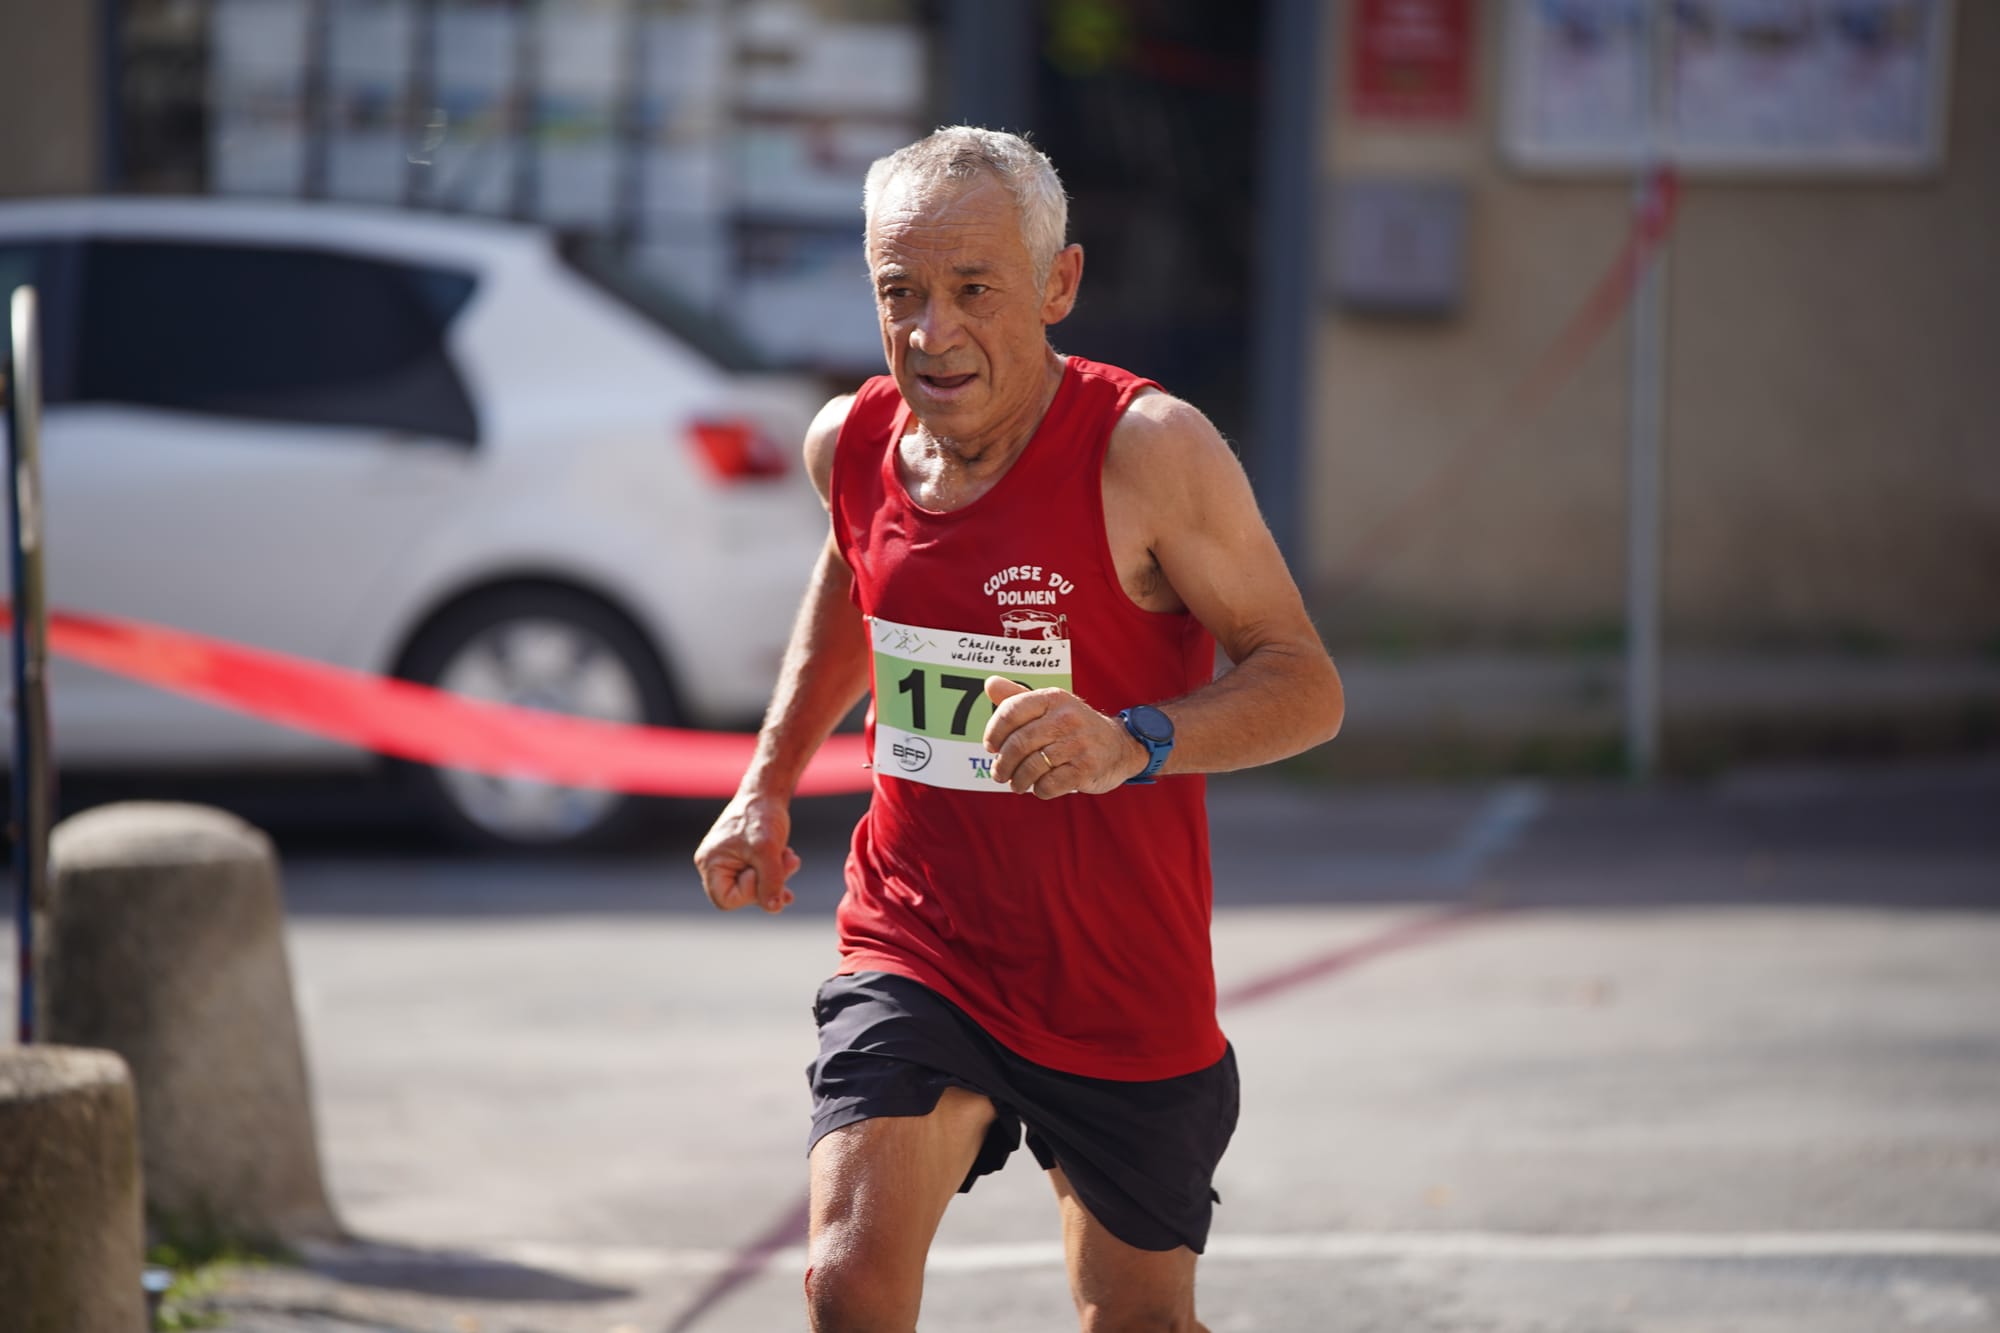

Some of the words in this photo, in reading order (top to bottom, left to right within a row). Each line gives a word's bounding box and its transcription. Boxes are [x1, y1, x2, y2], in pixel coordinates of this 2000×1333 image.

[983, 565, 1042, 595] COURSE
[1048, 572, 1075, 595] DU
[997, 591, 1056, 605] DOLMEN
[958, 637, 1022, 656] Challenge
[1030, 645, 1053, 655] des
[951, 651, 995, 664] vallées
[1003, 656, 1061, 668] cévenoles
[899, 669, 1033, 736] 17
[893, 743, 926, 761] BFP
[968, 757, 993, 770] TU
